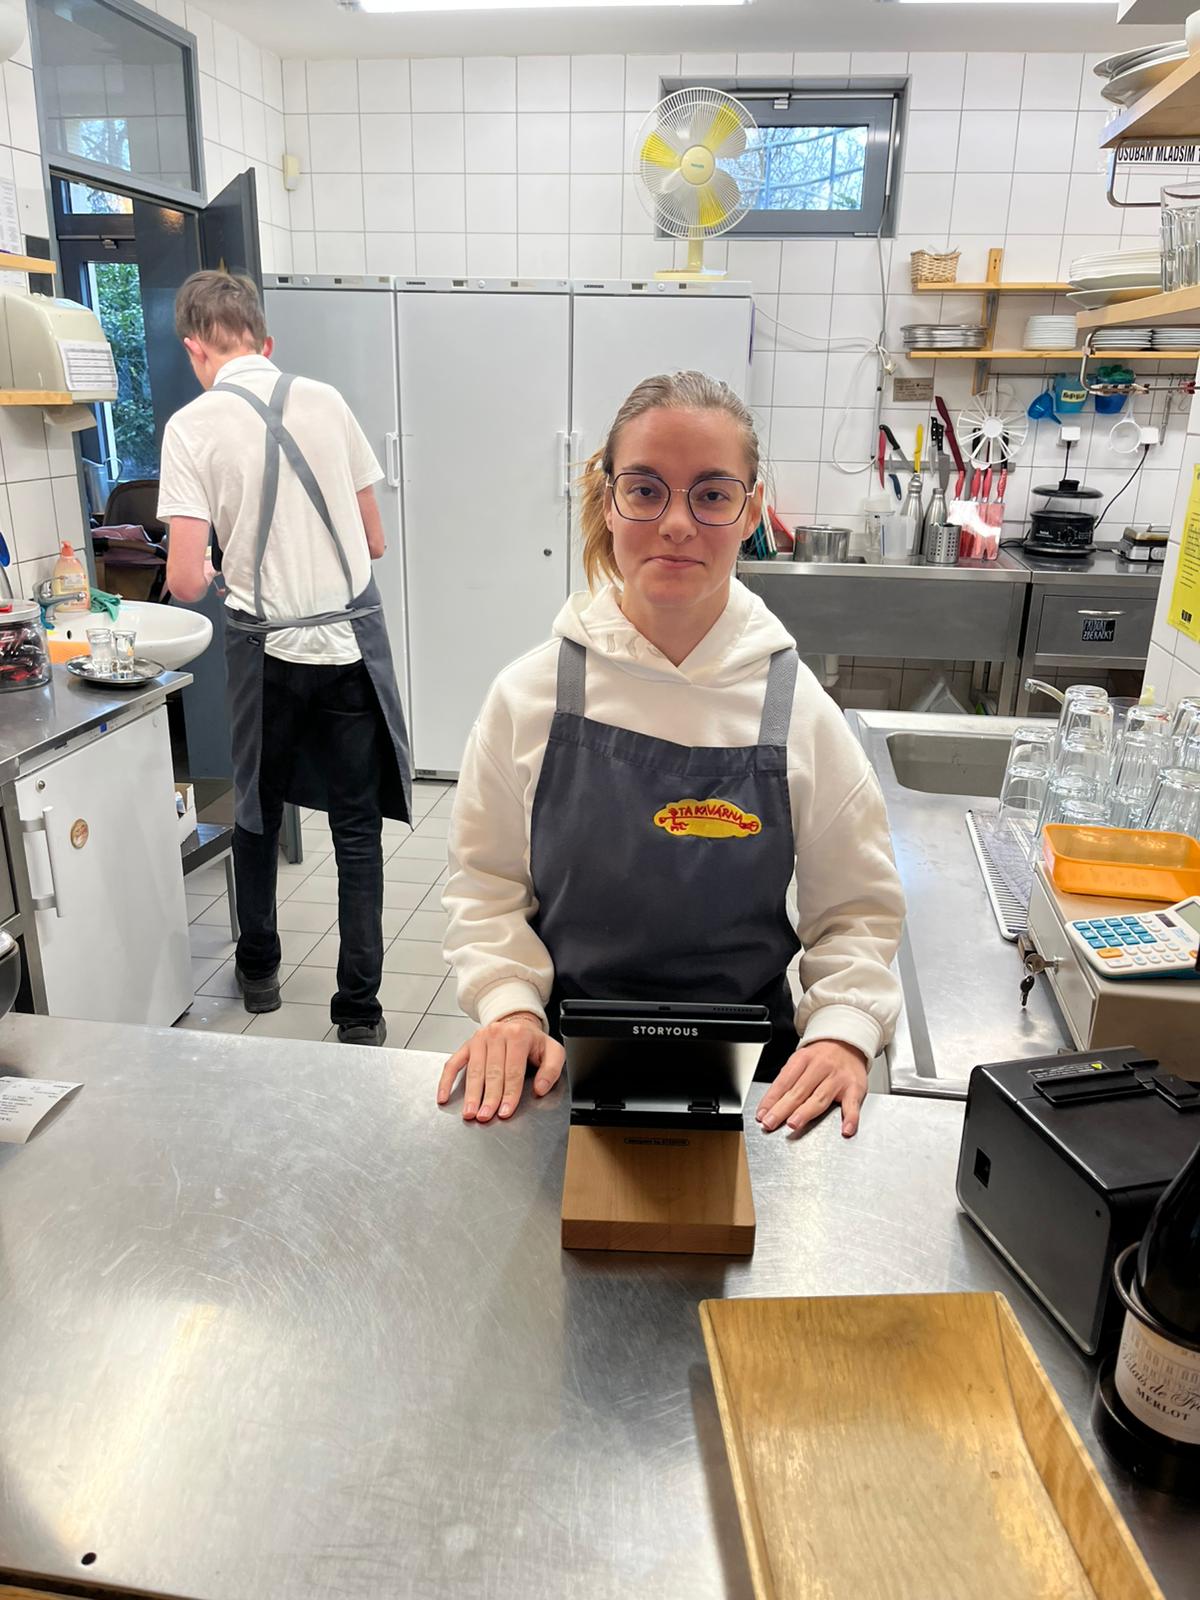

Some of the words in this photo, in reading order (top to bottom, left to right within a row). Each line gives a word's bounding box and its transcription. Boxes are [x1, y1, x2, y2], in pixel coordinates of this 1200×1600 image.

[632, 1025, 699, 1037] STORYOUS
[1149, 1384, 1167, 1397] de
[1136, 1386, 1191, 1421] MERLOT
